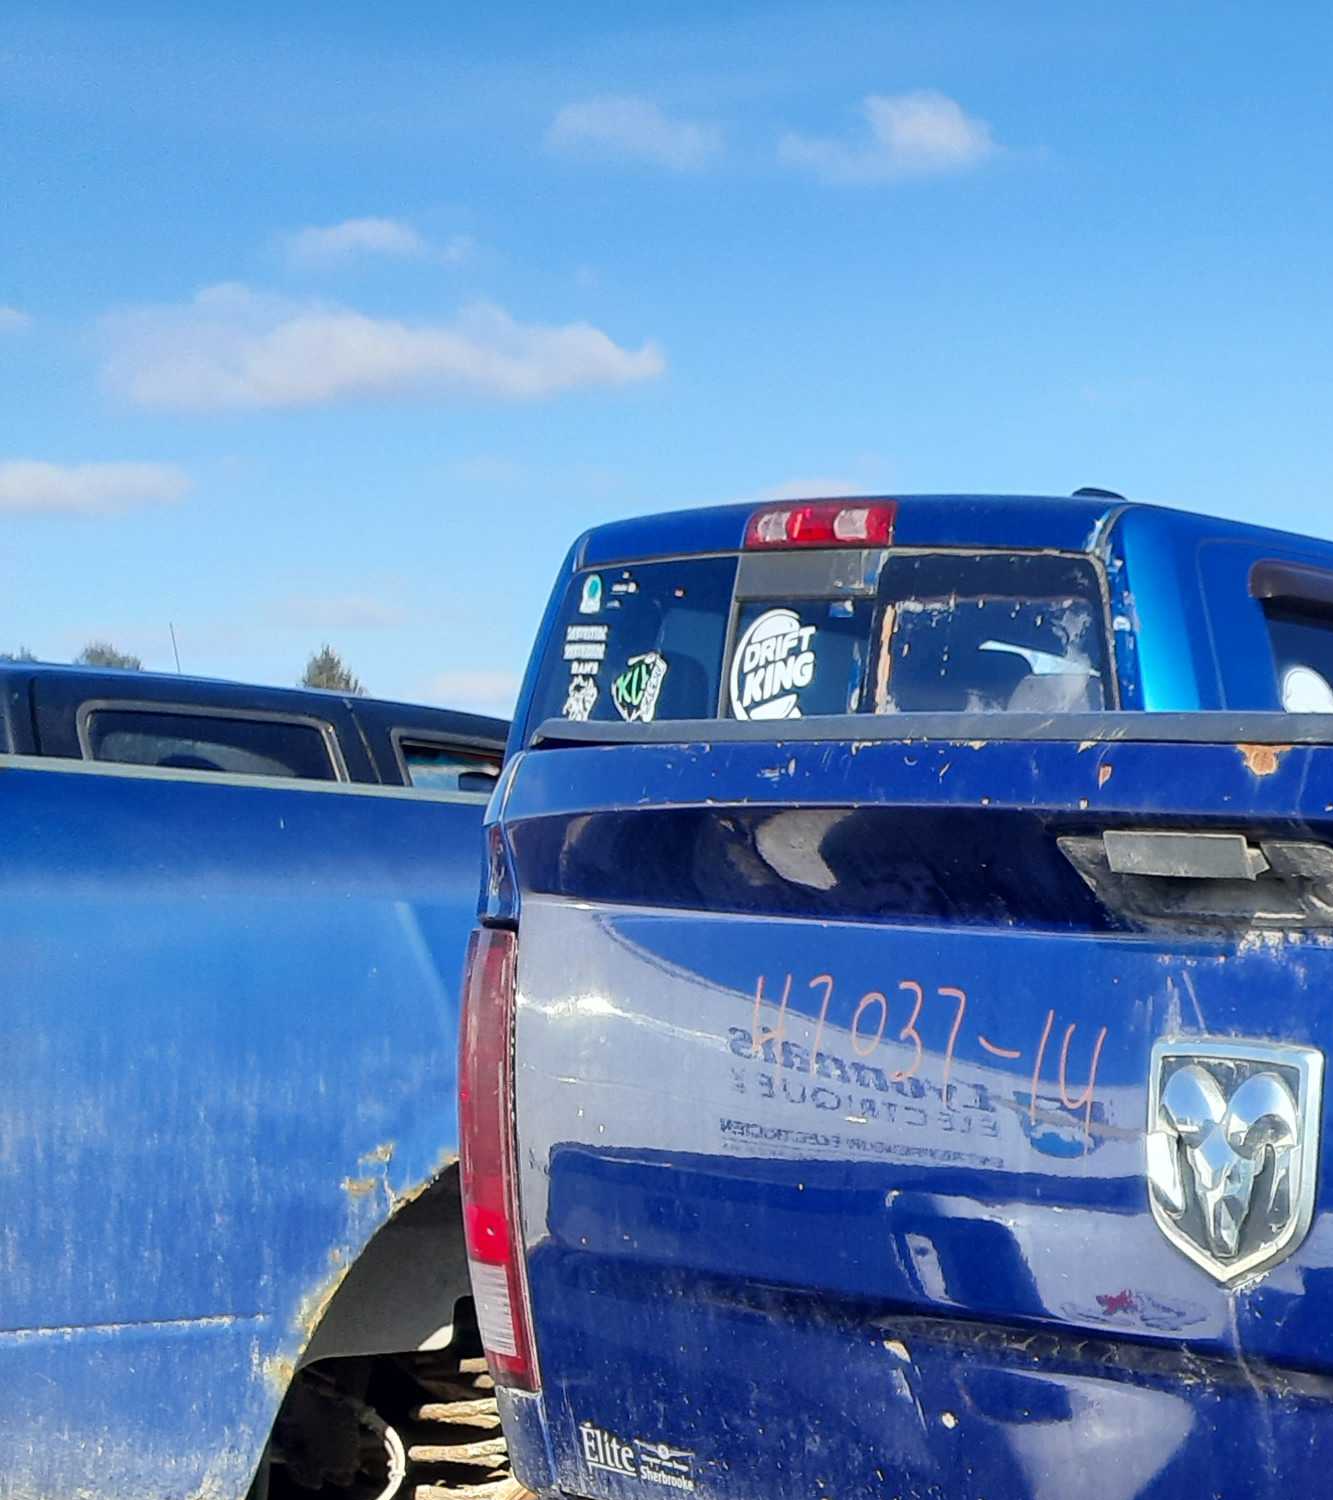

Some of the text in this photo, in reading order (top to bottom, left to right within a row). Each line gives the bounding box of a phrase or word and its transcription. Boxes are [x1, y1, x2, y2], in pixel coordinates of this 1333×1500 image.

[743, 626, 816, 674] DRIFT
[742, 651, 815, 708] KING
[640, 1465, 695, 1492] Sherbrooke
